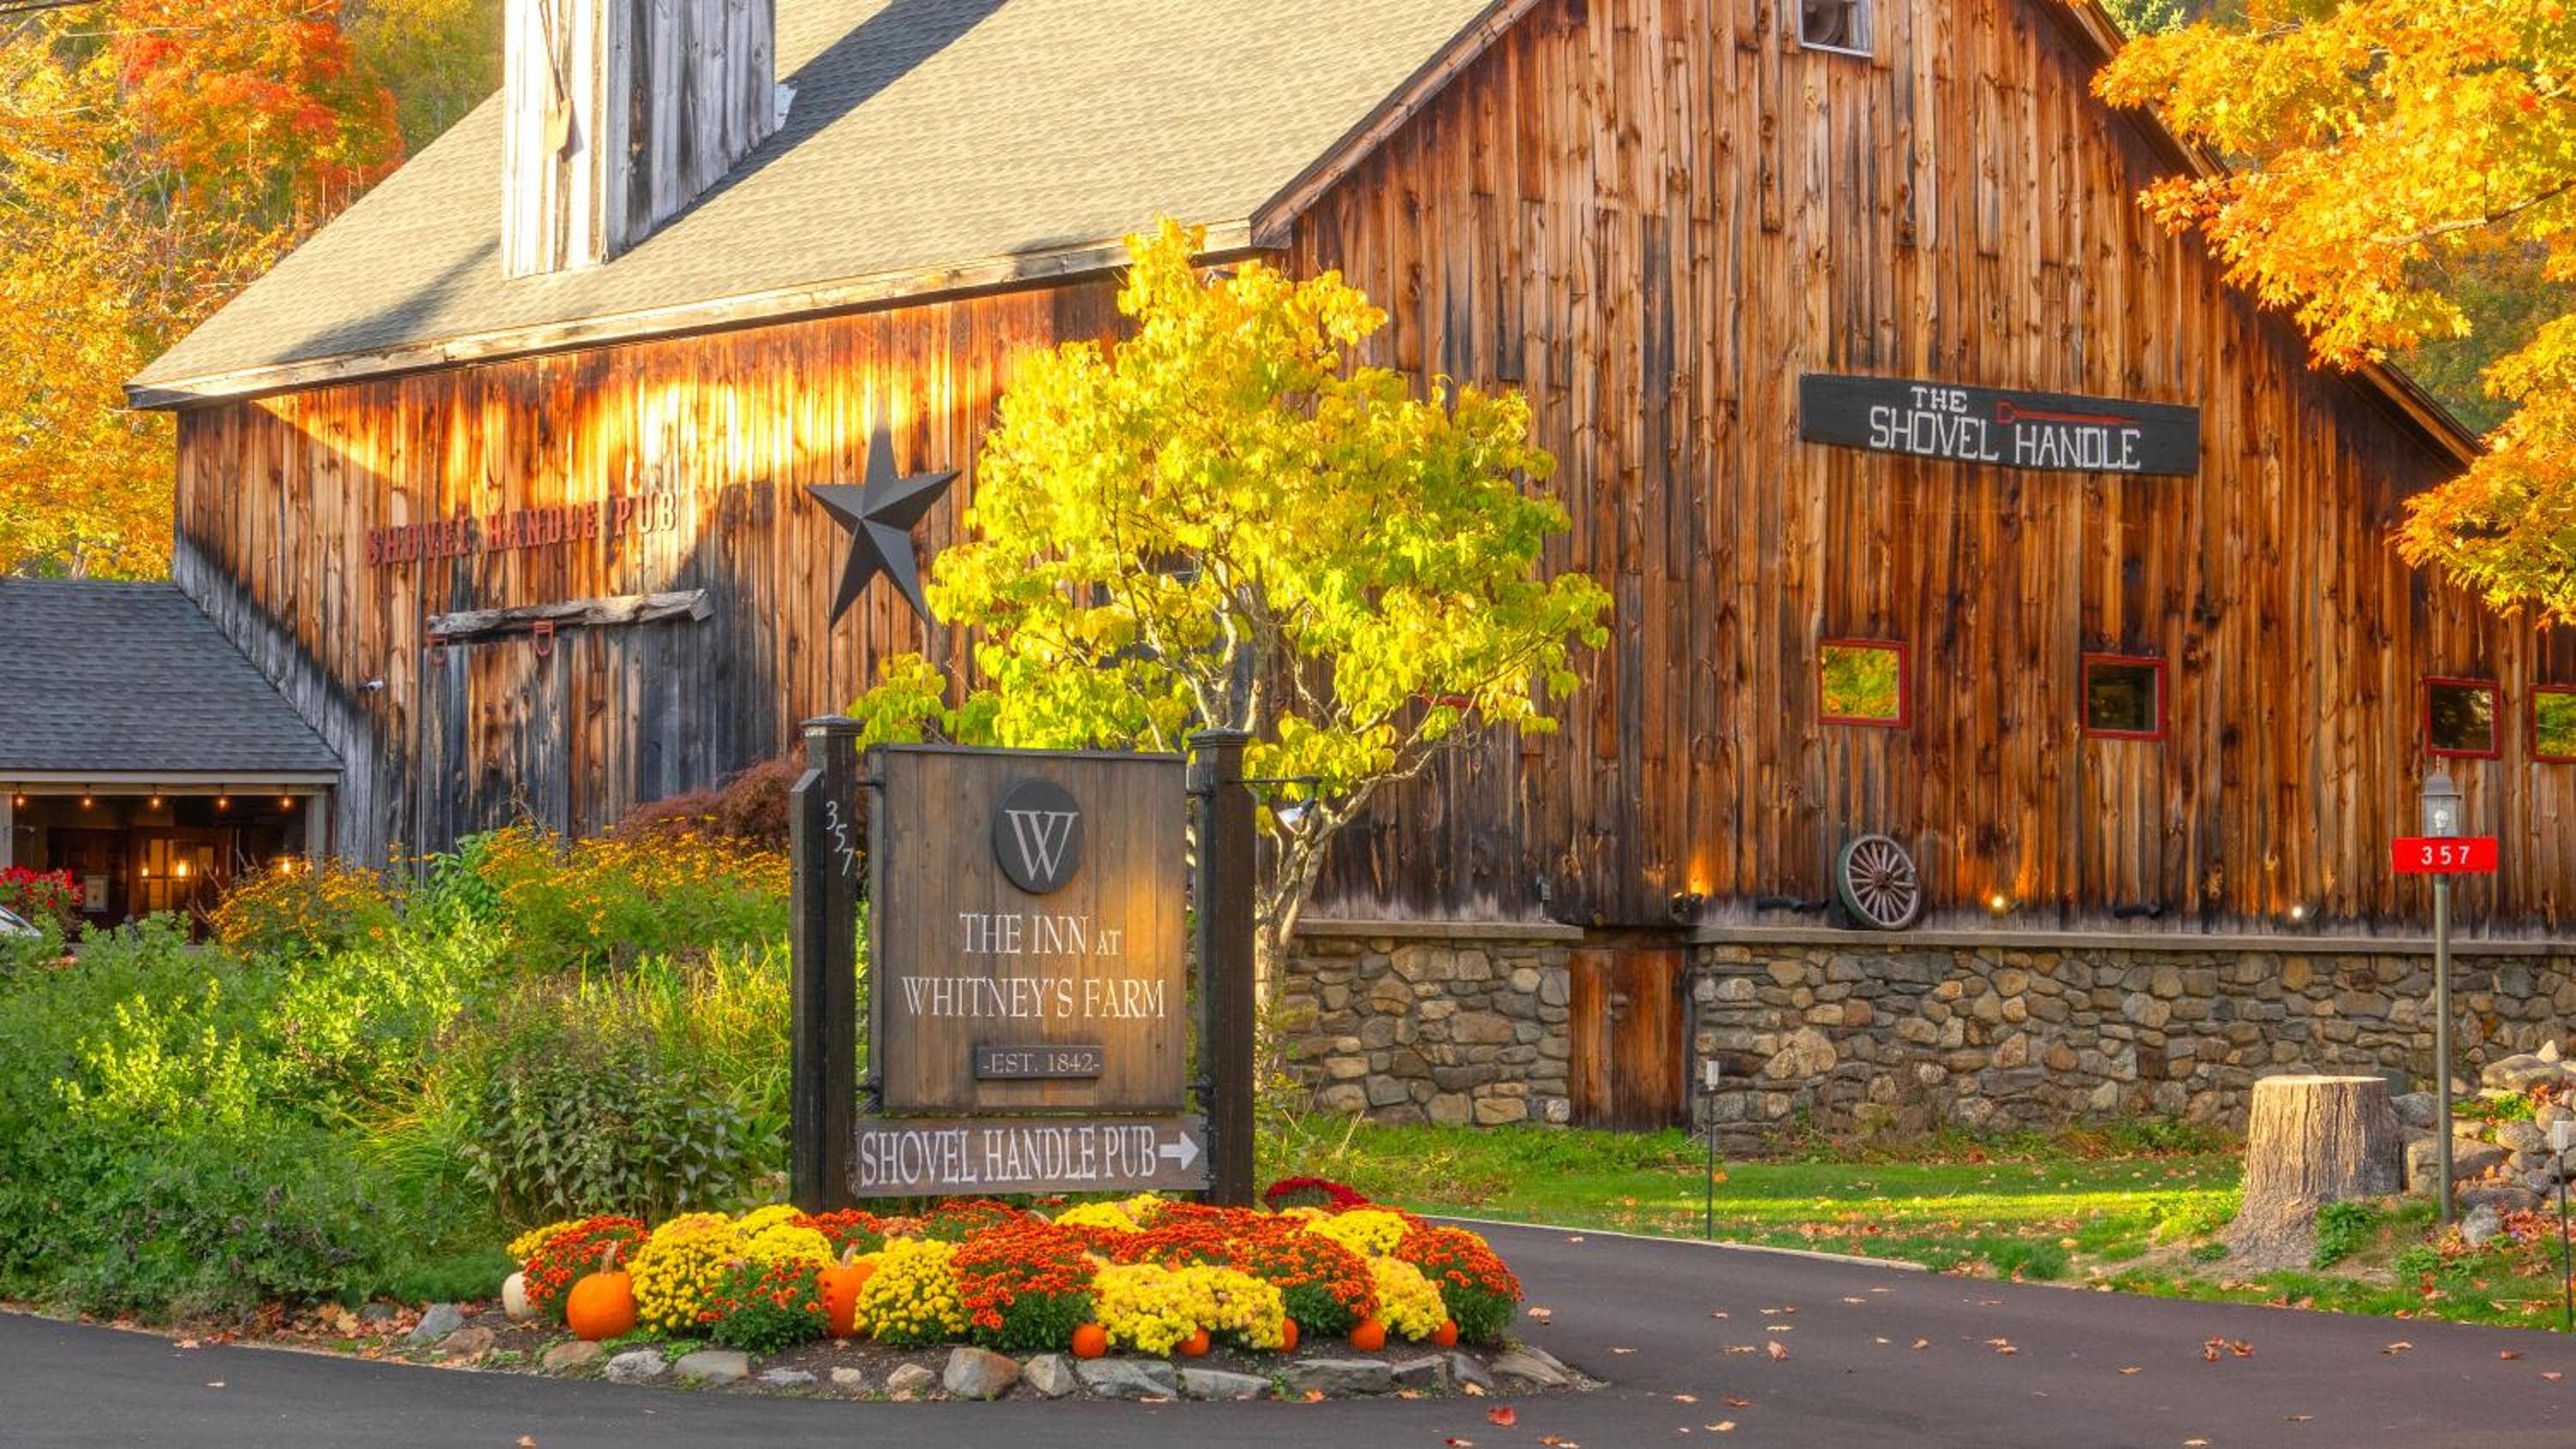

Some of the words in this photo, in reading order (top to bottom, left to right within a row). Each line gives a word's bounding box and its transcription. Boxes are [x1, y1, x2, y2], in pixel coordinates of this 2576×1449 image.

[1911, 386, 1968, 414] THE
[1869, 406, 2000, 462] SHOVEL
[2014, 423, 2141, 470] HANDLE
[367, 515, 471, 567] SHOVEL
[486, 500, 599, 552] HANDLE
[615, 492, 677, 538] PUB
[1005, 809, 1080, 883] W
[959, 912, 1022, 955] THE
[1031, 915, 1089, 955] INN
[1096, 931, 1121, 956] AT
[902, 976, 1073, 1018] WHITNEY'S
[1084, 978, 1166, 1018] FARM
[860, 1129, 978, 1188] SHOVEL
[983, 1125, 1097, 1184] HANDLE
[1103, 1125, 1157, 1179] PUB
